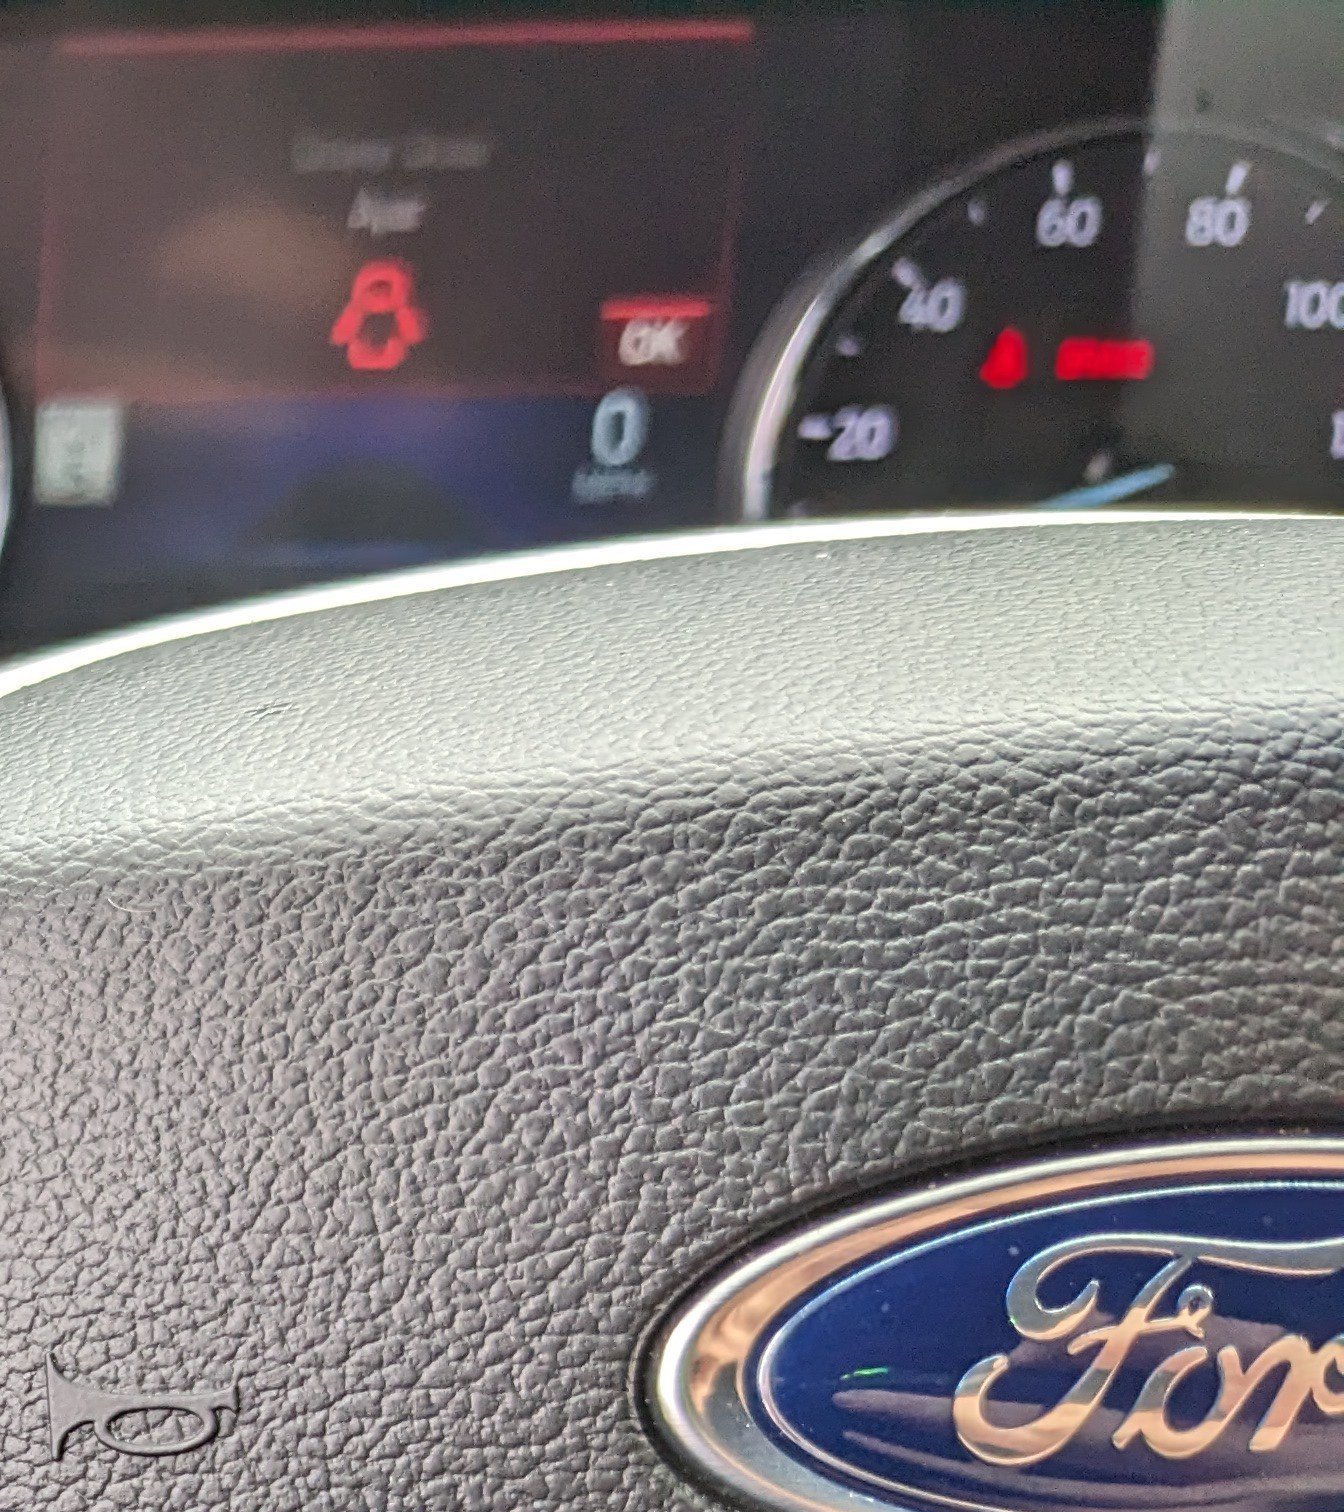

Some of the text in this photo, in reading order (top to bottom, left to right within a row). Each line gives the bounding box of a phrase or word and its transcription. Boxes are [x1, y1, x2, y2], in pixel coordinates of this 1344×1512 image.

[1036, 197, 1101, 247] 60
[1186, 197, 1251, 247] 80
[898, 280, 966, 332] 40
[619, 319, 690, 367] OK
[591, 386, 648, 467] 0
[828, 405, 898, 461] 20
